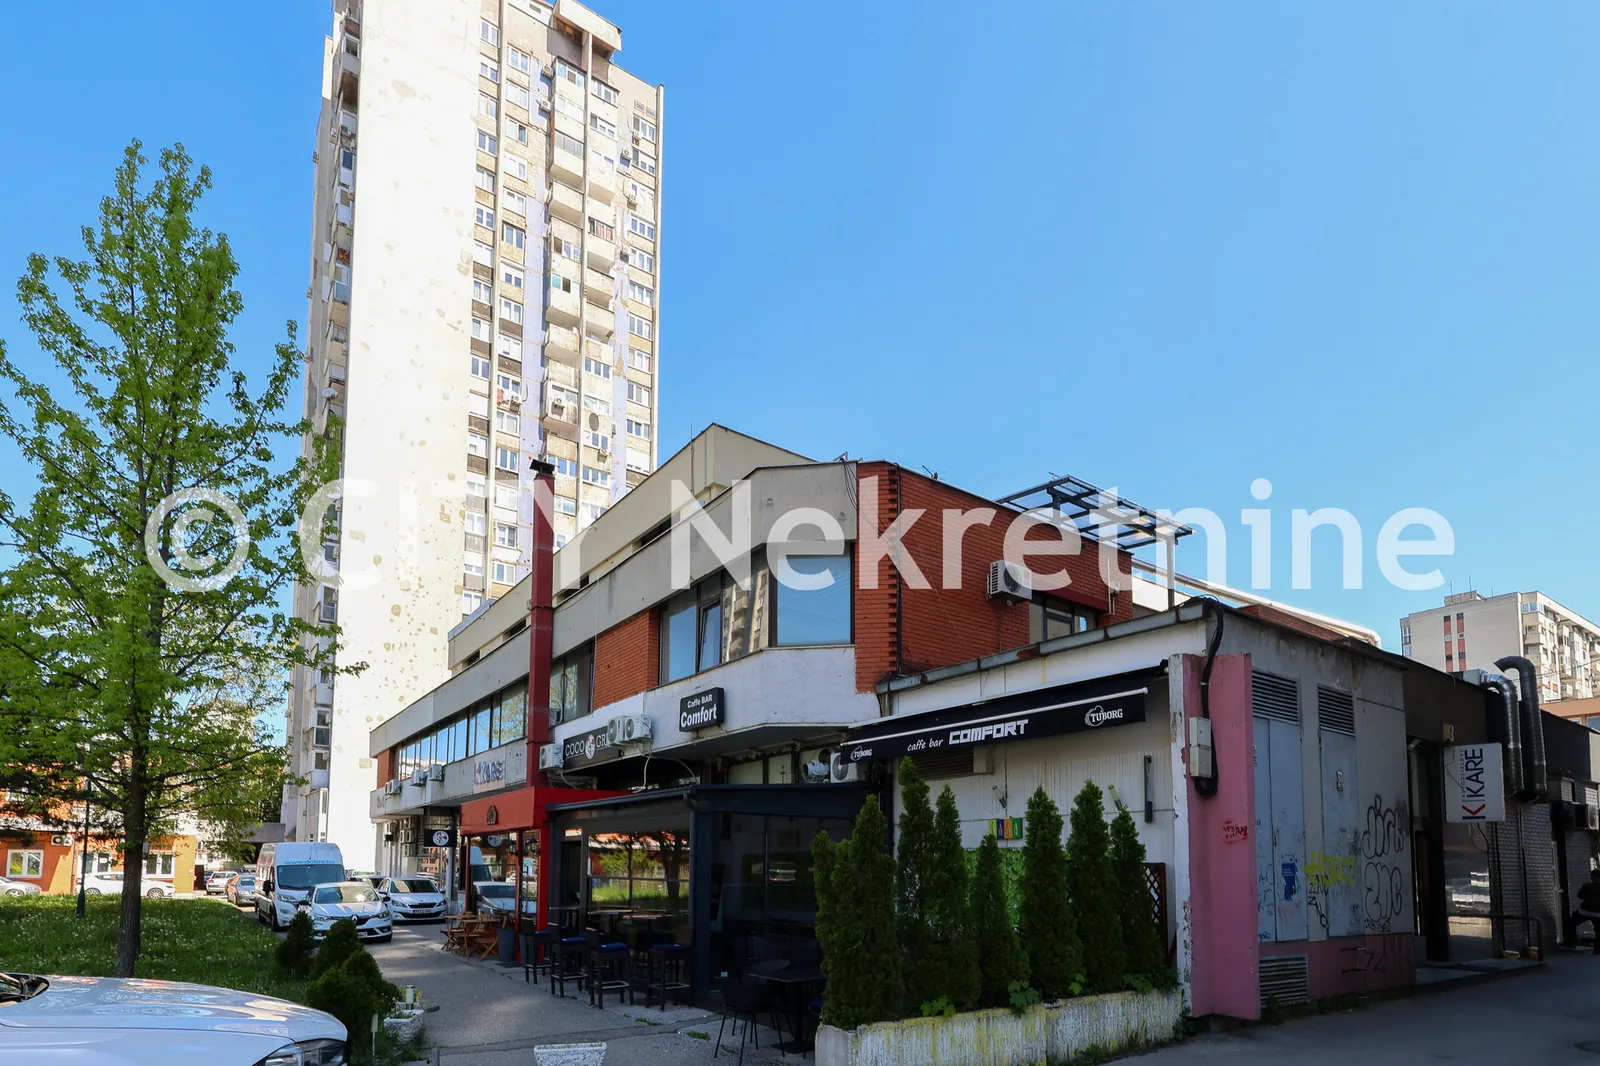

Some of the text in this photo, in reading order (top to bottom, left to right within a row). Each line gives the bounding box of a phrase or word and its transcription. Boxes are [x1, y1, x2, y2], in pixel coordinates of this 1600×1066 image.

[687, 694, 713, 708] Caffe BAR
[681, 704, 717, 728] Comfort
[1090, 708, 1123, 723] TUBORG
[907, 719, 1029, 752] caffe bar COMFORT
[565, 740, 585, 757] COCO
[854, 749, 873, 759] TUBORG
[1464, 748, 1485, 798] KARE
